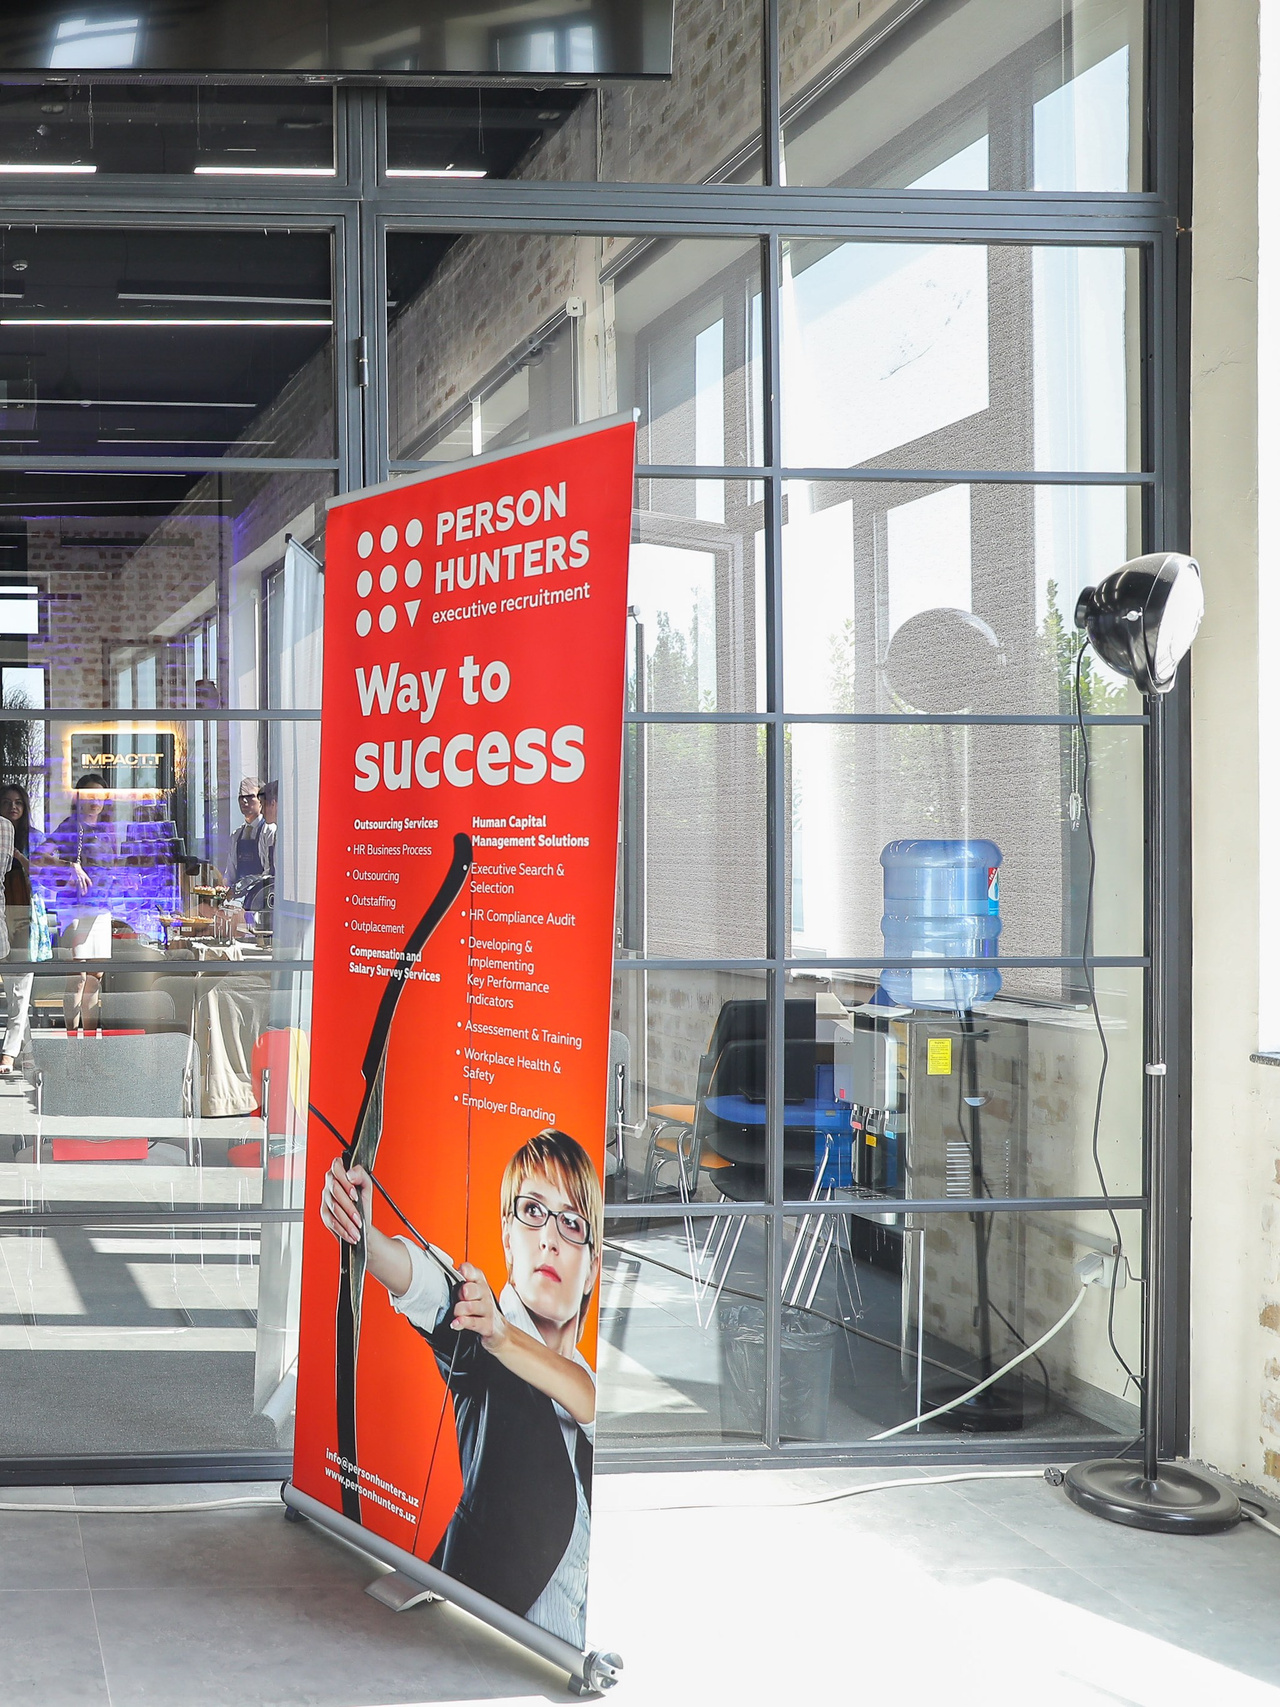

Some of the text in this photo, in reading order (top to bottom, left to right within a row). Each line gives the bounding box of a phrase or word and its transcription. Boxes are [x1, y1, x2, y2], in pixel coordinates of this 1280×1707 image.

[436, 481, 567, 546] PERSON
[434, 530, 590, 594] HUNTERS
[432, 582, 591, 624] executive recruitment
[354, 655, 511, 724] Way to
[81, 753, 165, 765] IMPACT.T
[354, 724, 586, 793] success
[353, 817, 439, 832] Outsourcing Services
[472, 815, 547, 830] Human Capital
[353, 844, 432, 856] HR Business Process
[471, 834, 590, 850] Management Solutions
[352, 869, 400, 884] Outsourcing
[470, 862, 565, 877] Executive Search &
[470, 881, 515, 894] Selection
[351, 894, 397, 910] Outstaffing
[469, 908, 576, 926] HR Compliance Audit
[350, 919, 405, 934] Outplacement
[349, 945, 422, 962] Compensation and
[468, 936, 533, 955] Developing &
[349, 962, 441, 983] Salary Survey Services
[467, 955, 535, 975] Implementing
[466, 973, 550, 993] Key Performance
[466, 992, 514, 1009] Indicators
[464, 1020, 583, 1050] Assessement & Training
[463, 1047, 562, 1074] Workplace Health &
[463, 1066, 495, 1084] Safety
[461, 1093, 556, 1125] Employer Branding
[325, 1447, 420, 1508] info@personhunters.uz
[324, 1466, 417, 1525] www.personhunters.uz
